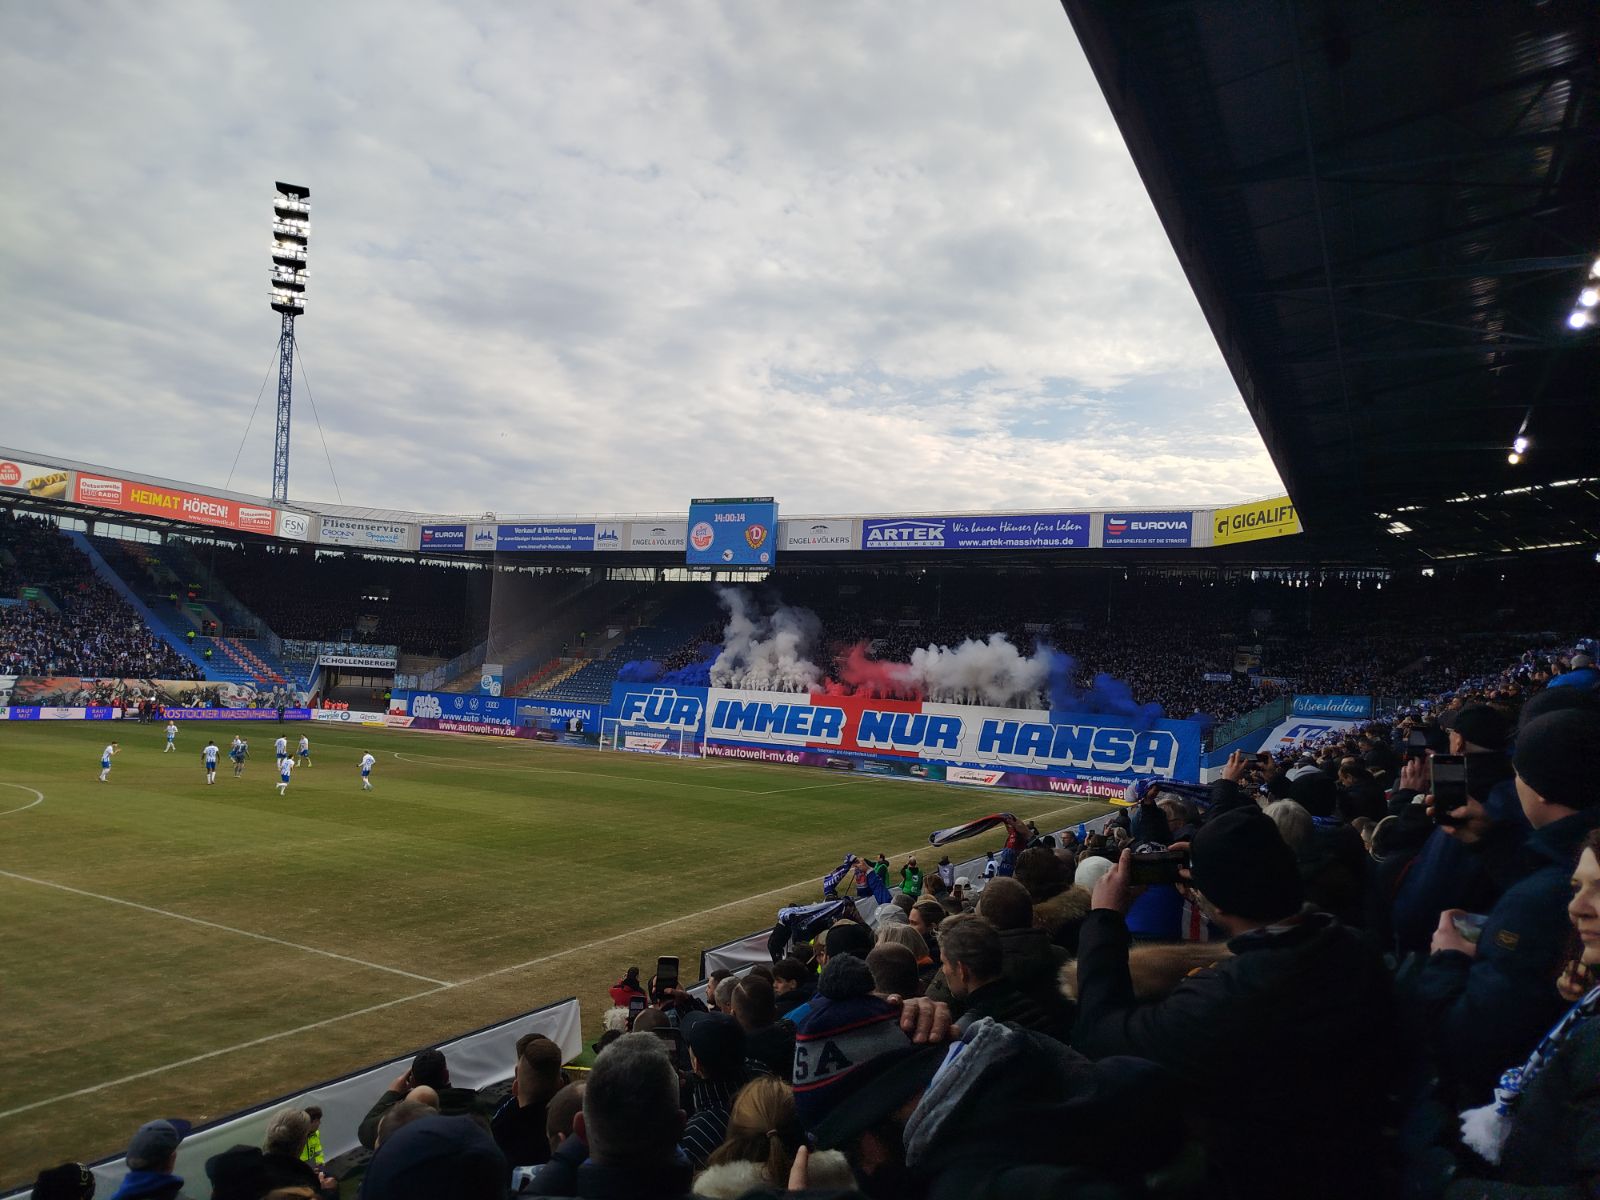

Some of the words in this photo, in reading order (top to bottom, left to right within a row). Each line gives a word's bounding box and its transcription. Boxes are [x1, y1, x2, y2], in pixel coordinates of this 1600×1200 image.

[130, 488, 180, 510] HEIMAT
[183, 498, 229, 519] HÖREN!
[714, 513, 746, 522] 14:00:14
[1232, 505, 1295, 529] GIGALIFT
[285, 519, 304, 532] FSN
[323, 519, 406, 534] Fliesenservice
[543, 527, 577, 535] Vermietung
[953, 521, 969, 532] Wir
[971, 521, 997, 533] bauen
[1000, 520, 1031, 532] Häuser
[1056, 519, 1082, 531] Leben
[1131, 521, 1188, 530] EUROVIA
[434, 531, 464, 539] EUROVIA
[868, 527, 945, 540] ARTEK
[959, 536, 1074, 547] www.artek-massivhaus.de
[321, 657, 396, 667] SCHOLLENBERGER
[439, 722, 516, 737] www.autowelt-mv.de
[620, 688, 703, 732] FÜR
[711, 698, 847, 745] IMMER
[856, 710, 967, 757] NUR
[975, 718, 1179, 778] HANSA
[699, 745, 800, 763] www.autowelt-mv.de
